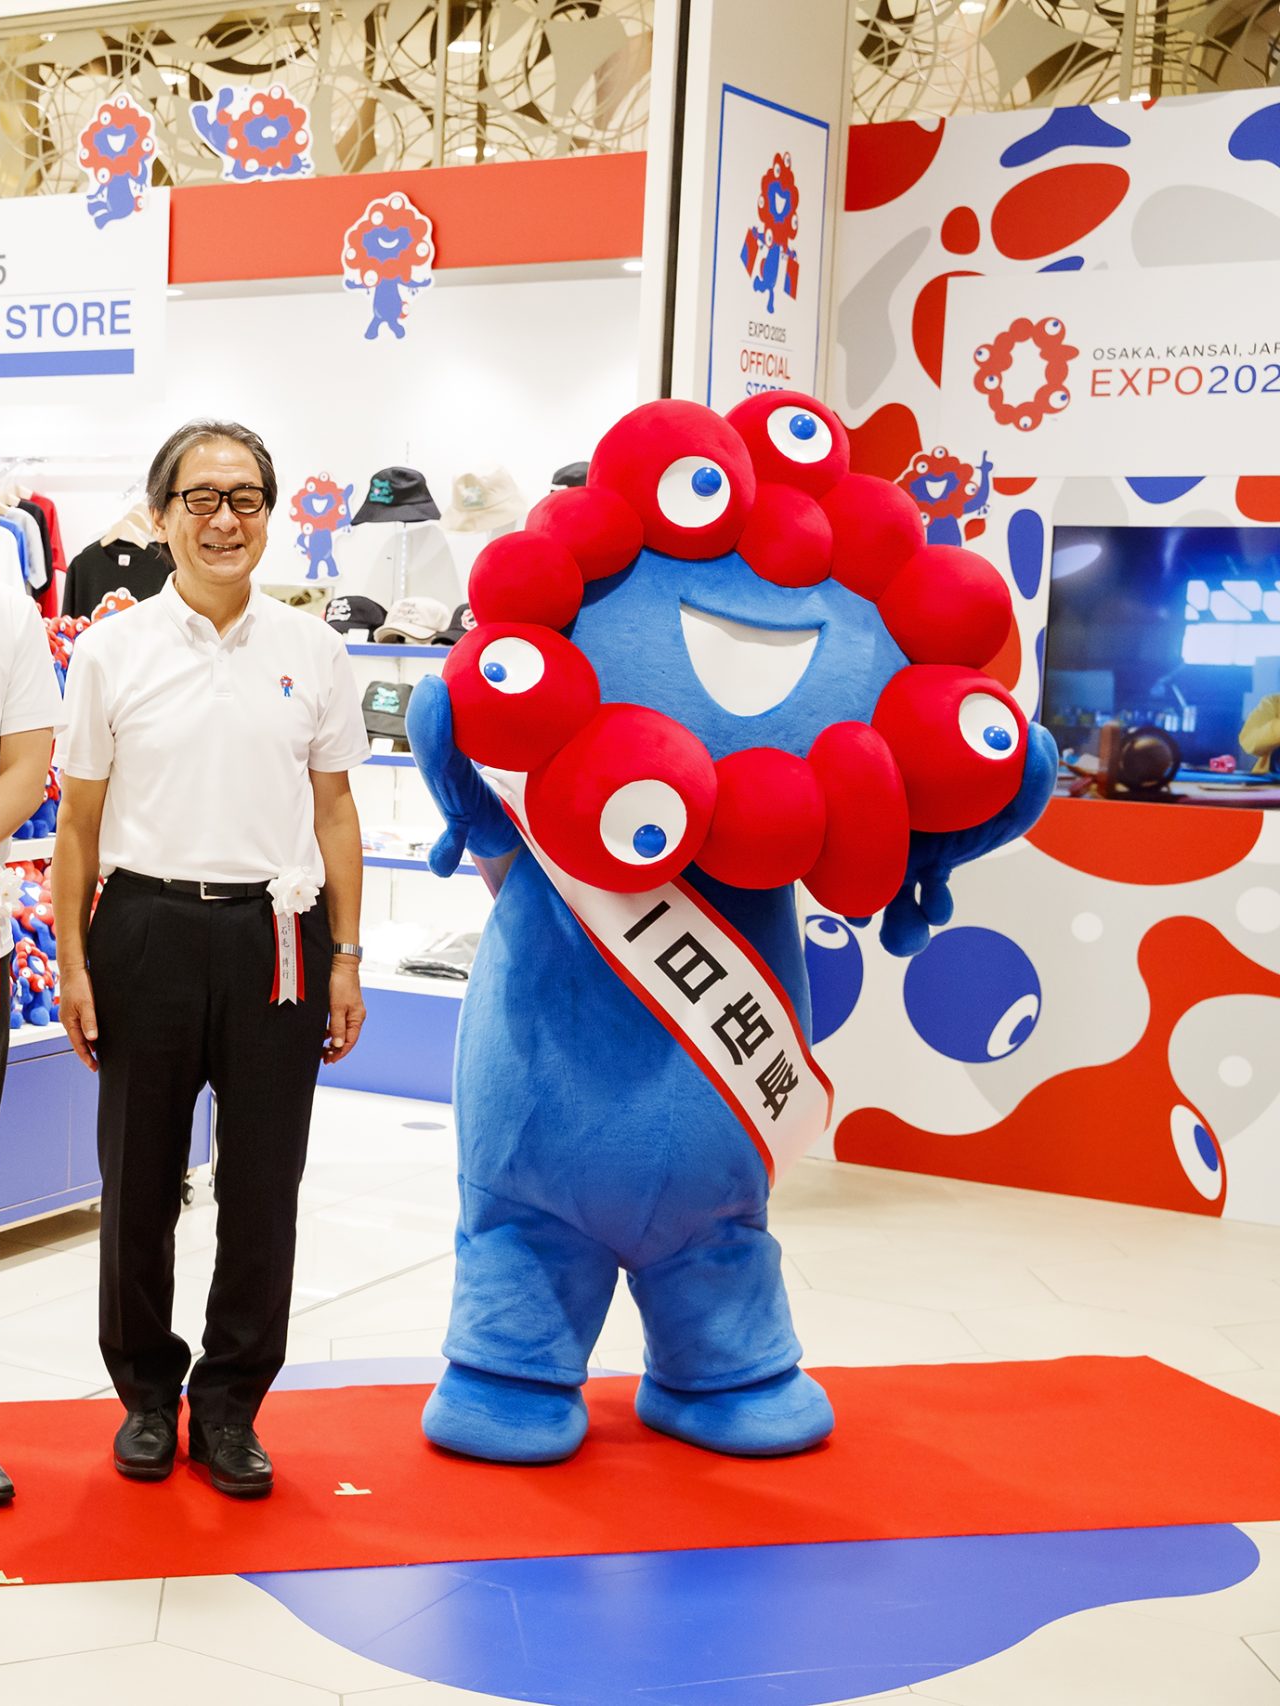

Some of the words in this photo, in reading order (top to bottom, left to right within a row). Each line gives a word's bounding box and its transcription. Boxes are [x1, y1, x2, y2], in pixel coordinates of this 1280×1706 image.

[6, 300, 131, 340] STORE
[740, 349, 791, 380] OFFICIAL
[1092, 347, 1161, 361] OSAKA,
[1166, 343, 1242, 358] KANSAI,
[623, 900, 799, 1122] 一日店長
